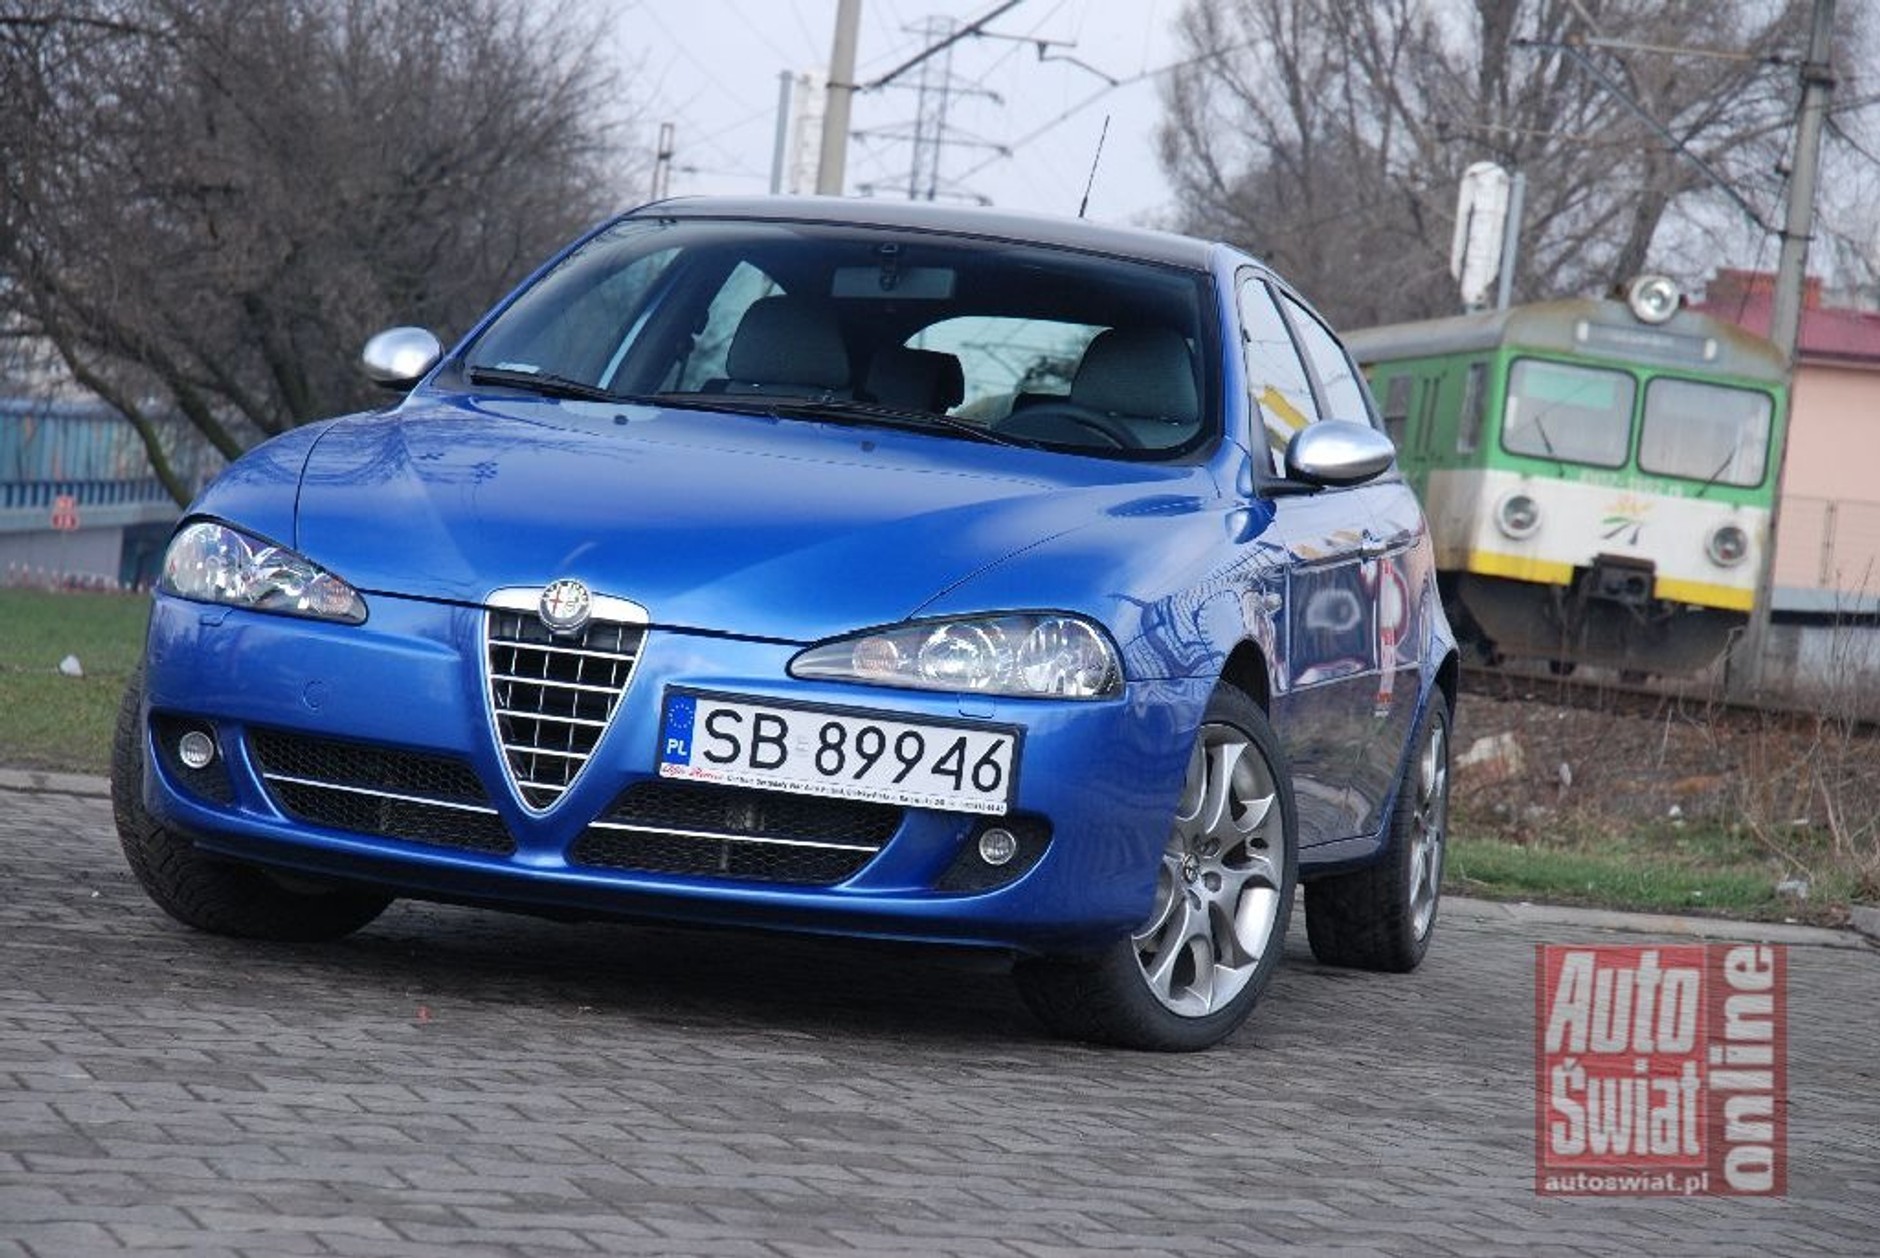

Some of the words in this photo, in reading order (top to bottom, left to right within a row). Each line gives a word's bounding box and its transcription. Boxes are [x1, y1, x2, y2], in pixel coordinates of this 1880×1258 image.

[666, 738, 688, 756] PL
[702, 708, 789, 770] SB
[815, 721, 1006, 793] 89946
